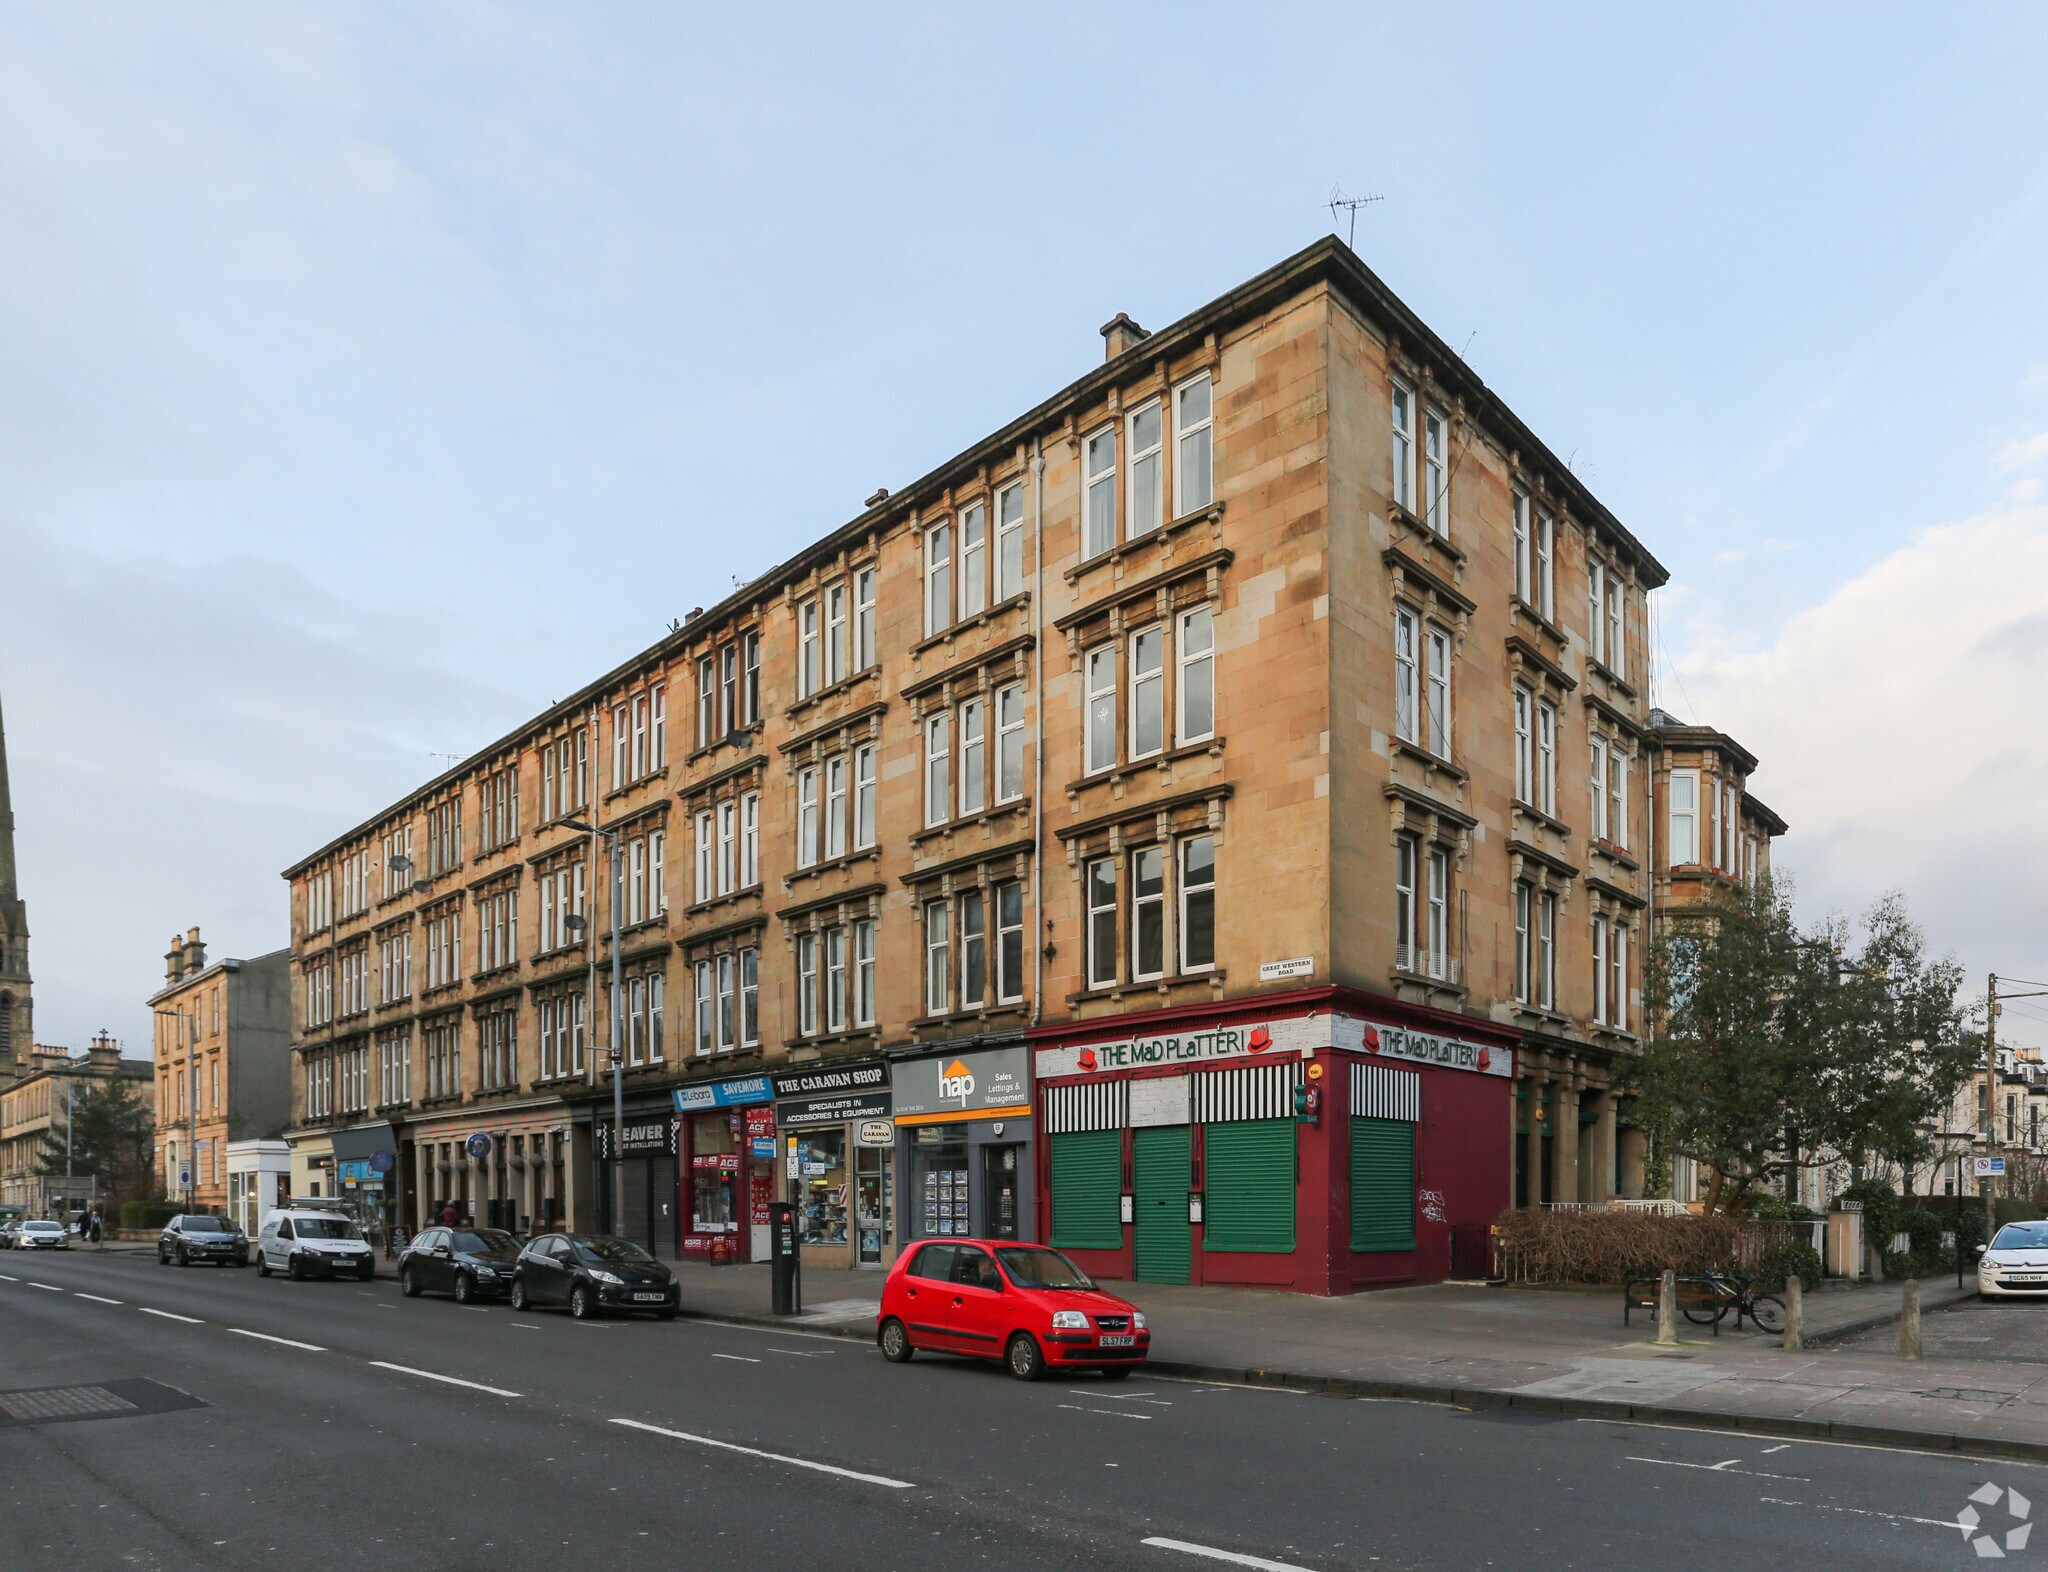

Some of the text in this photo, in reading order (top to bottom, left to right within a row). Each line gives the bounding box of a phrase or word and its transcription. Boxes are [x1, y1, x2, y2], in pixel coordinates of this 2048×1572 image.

[1262, 960, 1311, 972] GREAT WESTERN
[1381, 1029, 1404, 1055] THE
[1100, 1044, 1128, 1067] THE
[777, 1068, 883, 1093] THE CARAVAN SHOP
[995, 1072, 1012, 1081] Sales
[722, 1078, 766, 1096] SAVEMORE
[937, 1060, 976, 1108] hap
[988, 1081, 1020, 1094] Lettings &
[808, 1099, 862, 1111] SPECIALISTS IN
[984, 1093, 1025, 1105] Management
[786, 1111, 832, 1123] ACCESSORIES
[842, 1107, 885, 1118] EQUIPMENT
[614, 1124, 664, 1141] EAVER
[748, 1124, 765, 1132] ACE
[630, 1141, 664, 1149] INSTALLATIONS
[720, 1159, 739, 1168] ACE
[1102, 1336, 1119, 1346] SL57
